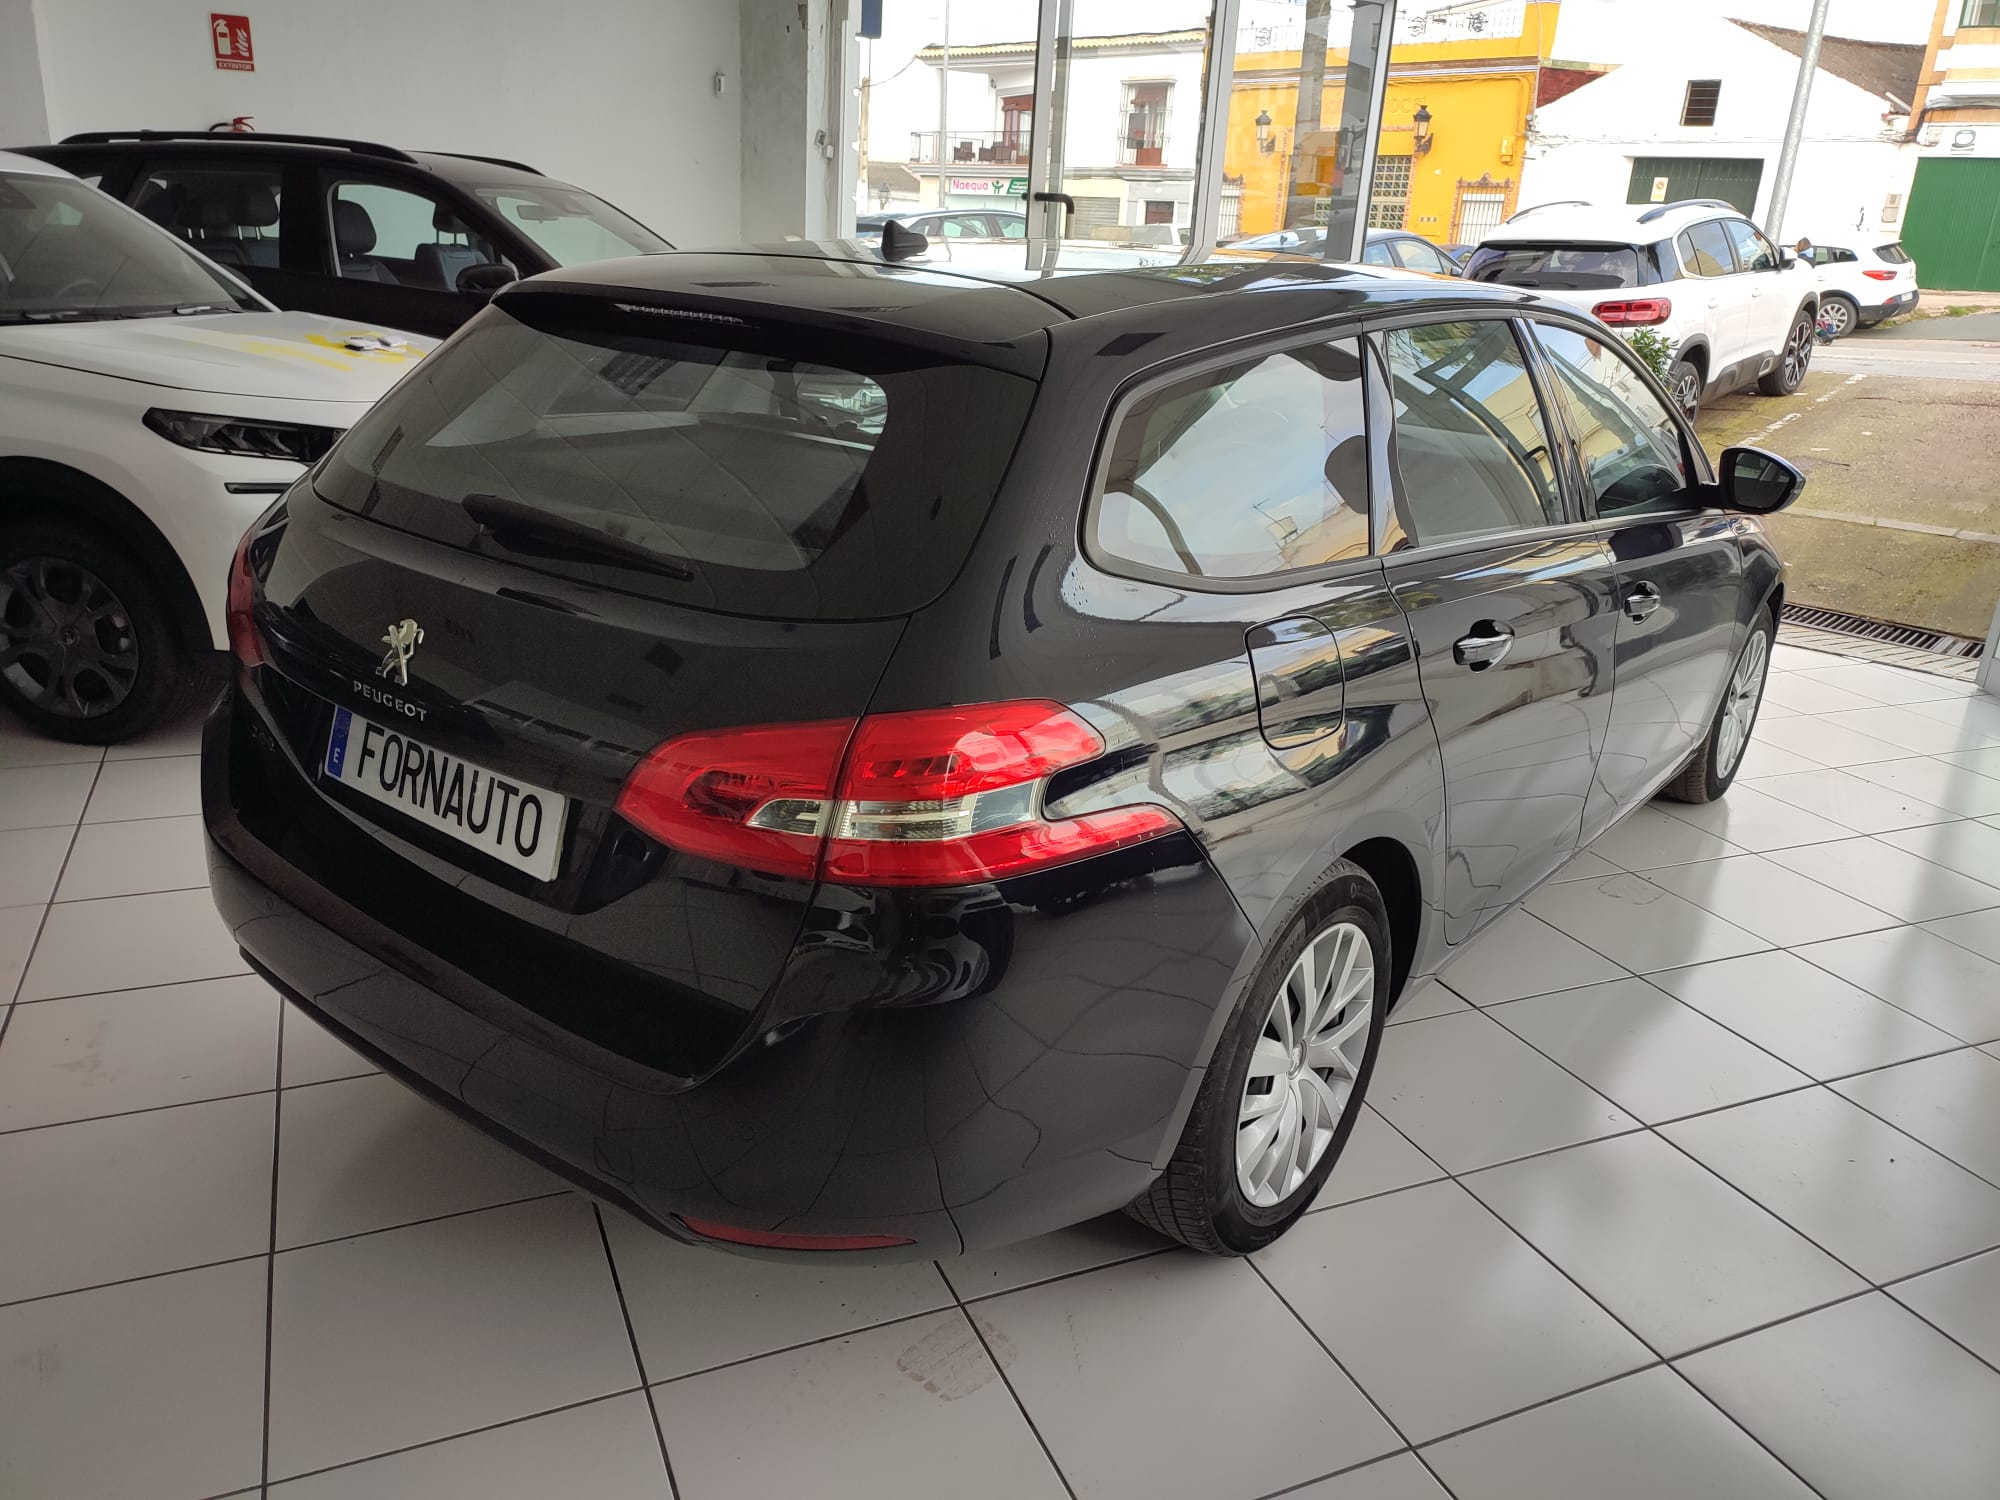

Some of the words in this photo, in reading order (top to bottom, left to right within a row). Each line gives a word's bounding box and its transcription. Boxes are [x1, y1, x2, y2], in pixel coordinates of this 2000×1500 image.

[953, 179, 989, 192] Naequa
[353, 680, 427, 722] PEUGEOT
[333, 747, 341, 763] E
[357, 722, 543, 857] FORNAUTO
